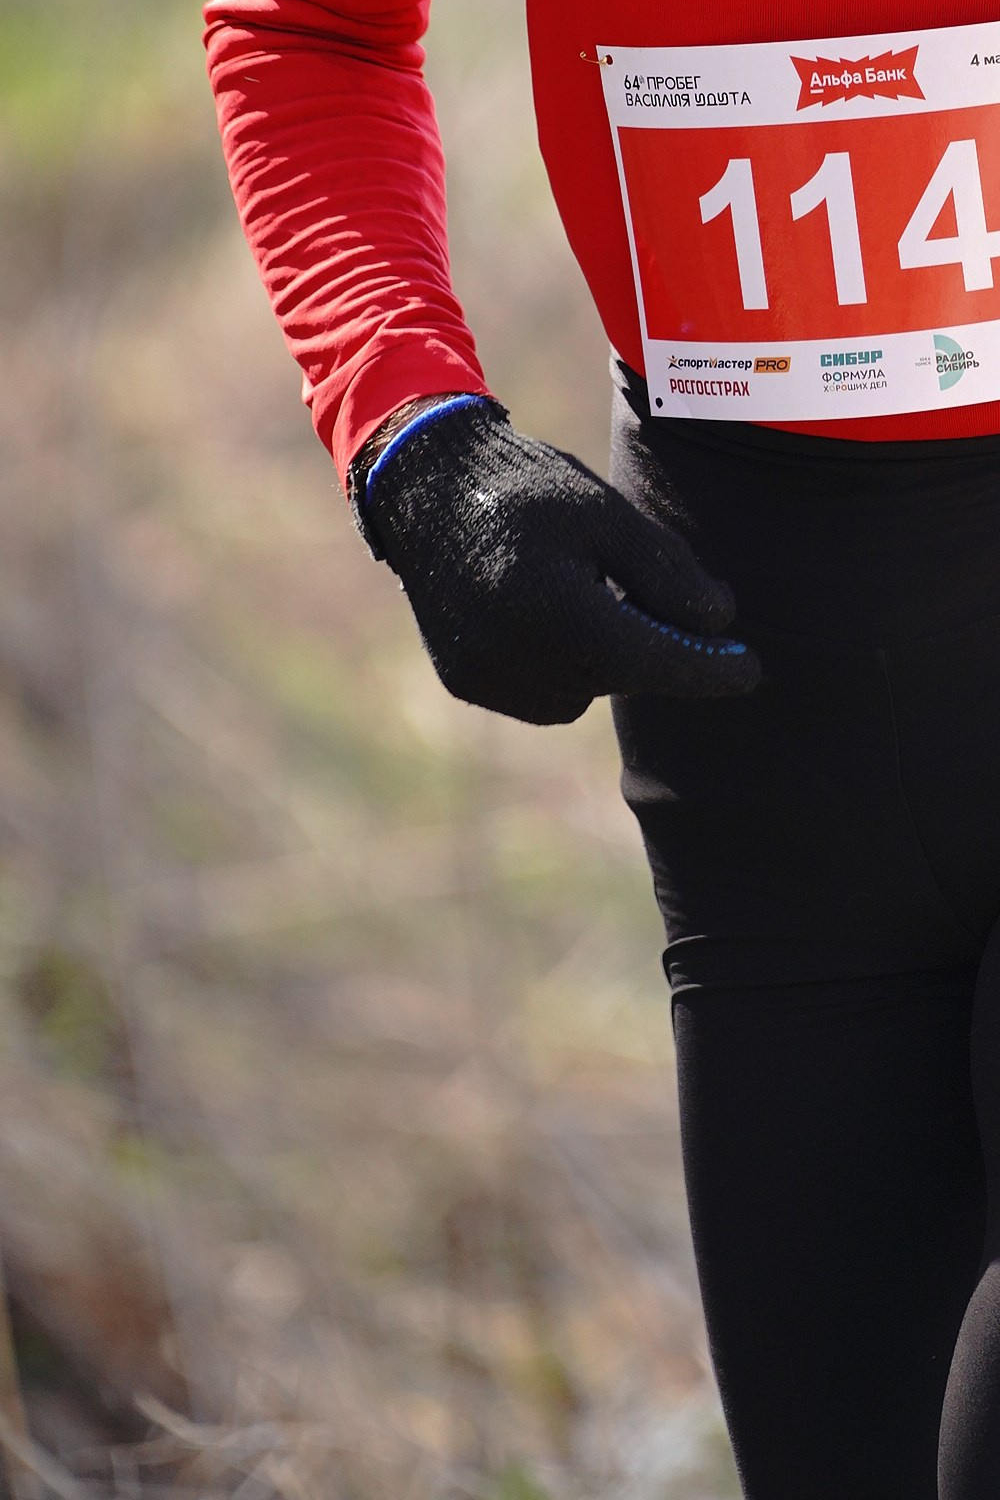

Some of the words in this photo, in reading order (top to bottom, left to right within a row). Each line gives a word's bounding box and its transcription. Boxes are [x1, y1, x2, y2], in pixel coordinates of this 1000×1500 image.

[970, 53, 980, 67] 4
[646, 75, 701, 90] ПРОБЕГ
[809, 70, 863, 93] Альфа
[864, 67, 907, 83] Банк
[625, 92, 691, 107] ВАСИЛИЯ
[755, 358, 788, 371] PRO
[820, 350, 883, 367] СИБУР
[936, 351, 974, 364] РАДИО
[936, 360, 980, 373] СИБИРЬ
[821, 368, 885, 383] ФОРМУЛА
[669, 378, 750, 397] РОСГОССТРАХ
[869, 380, 887, 391] ДЕЛ
